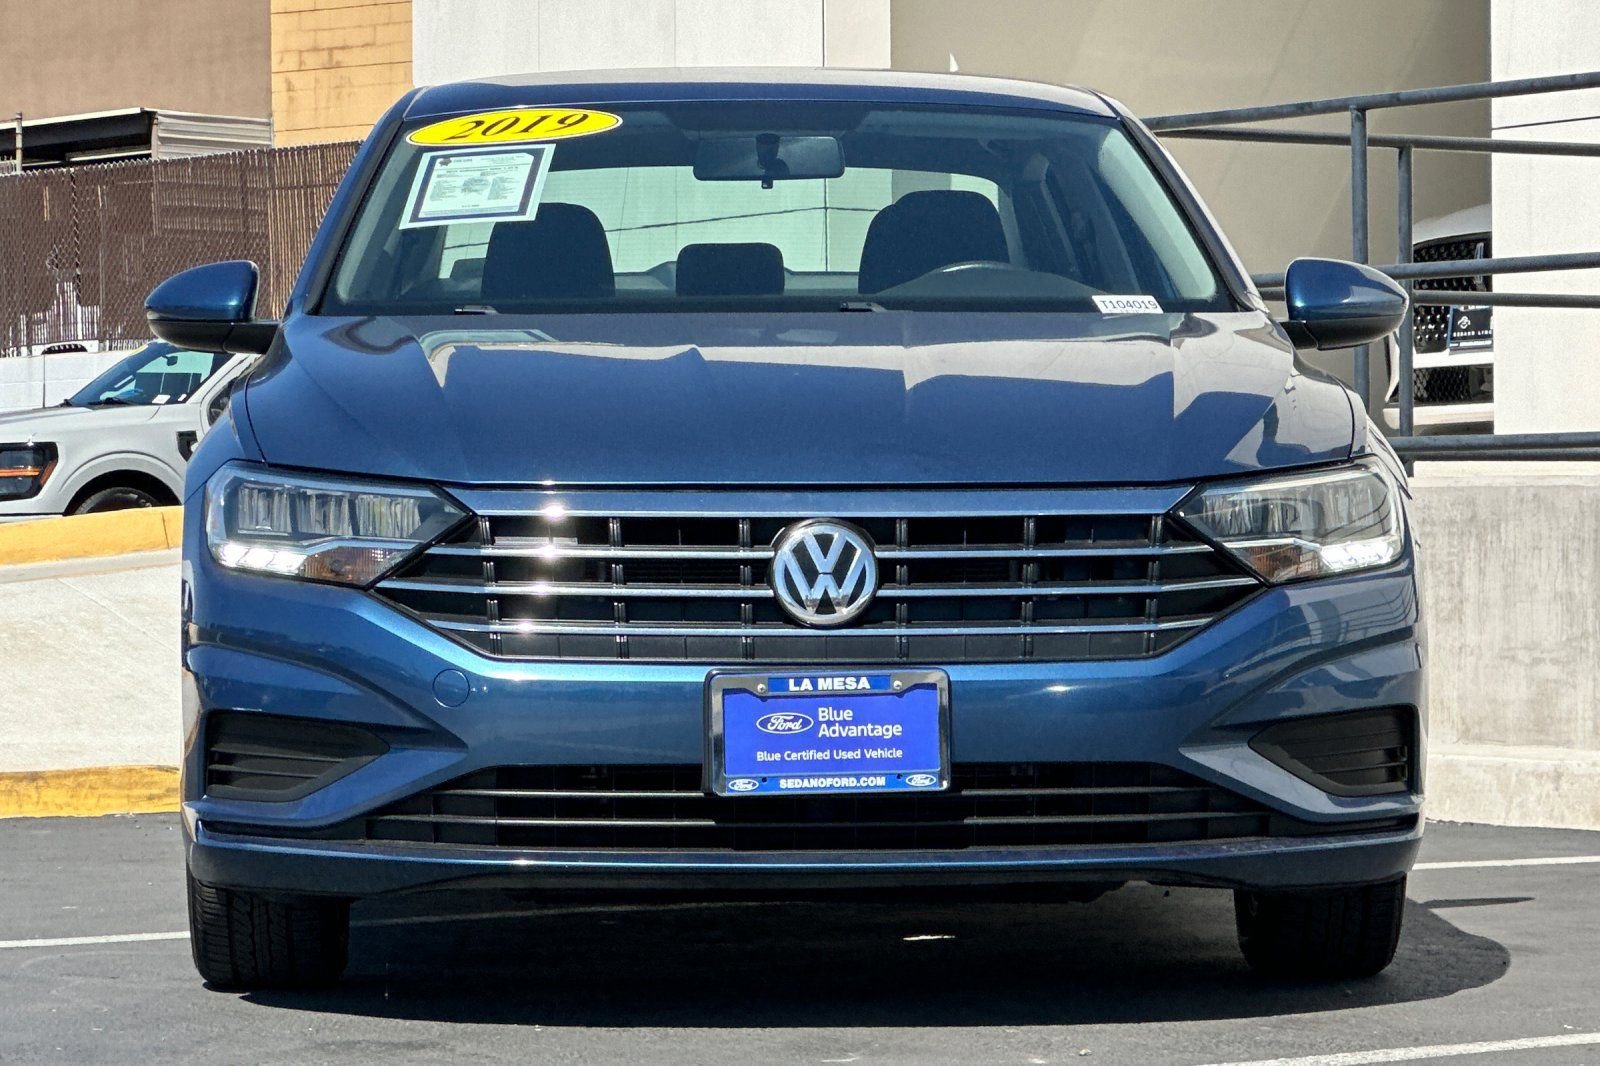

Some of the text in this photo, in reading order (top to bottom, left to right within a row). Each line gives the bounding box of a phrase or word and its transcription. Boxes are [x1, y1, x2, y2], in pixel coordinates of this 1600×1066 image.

[444, 113, 589, 141] 2019
[1100, 300, 1158, 310] T104019
[779, 527, 872, 620] VW
[789, 676, 871, 692] LA MESA
[818, 706, 853, 722] Blue
[767, 715, 802, 731] Ford
[818, 722, 903, 739] Advantage
[756, 748, 903, 762] Blue Certified Used Vehicle
[779, 777, 886, 789] SEDANOFORD.COM
